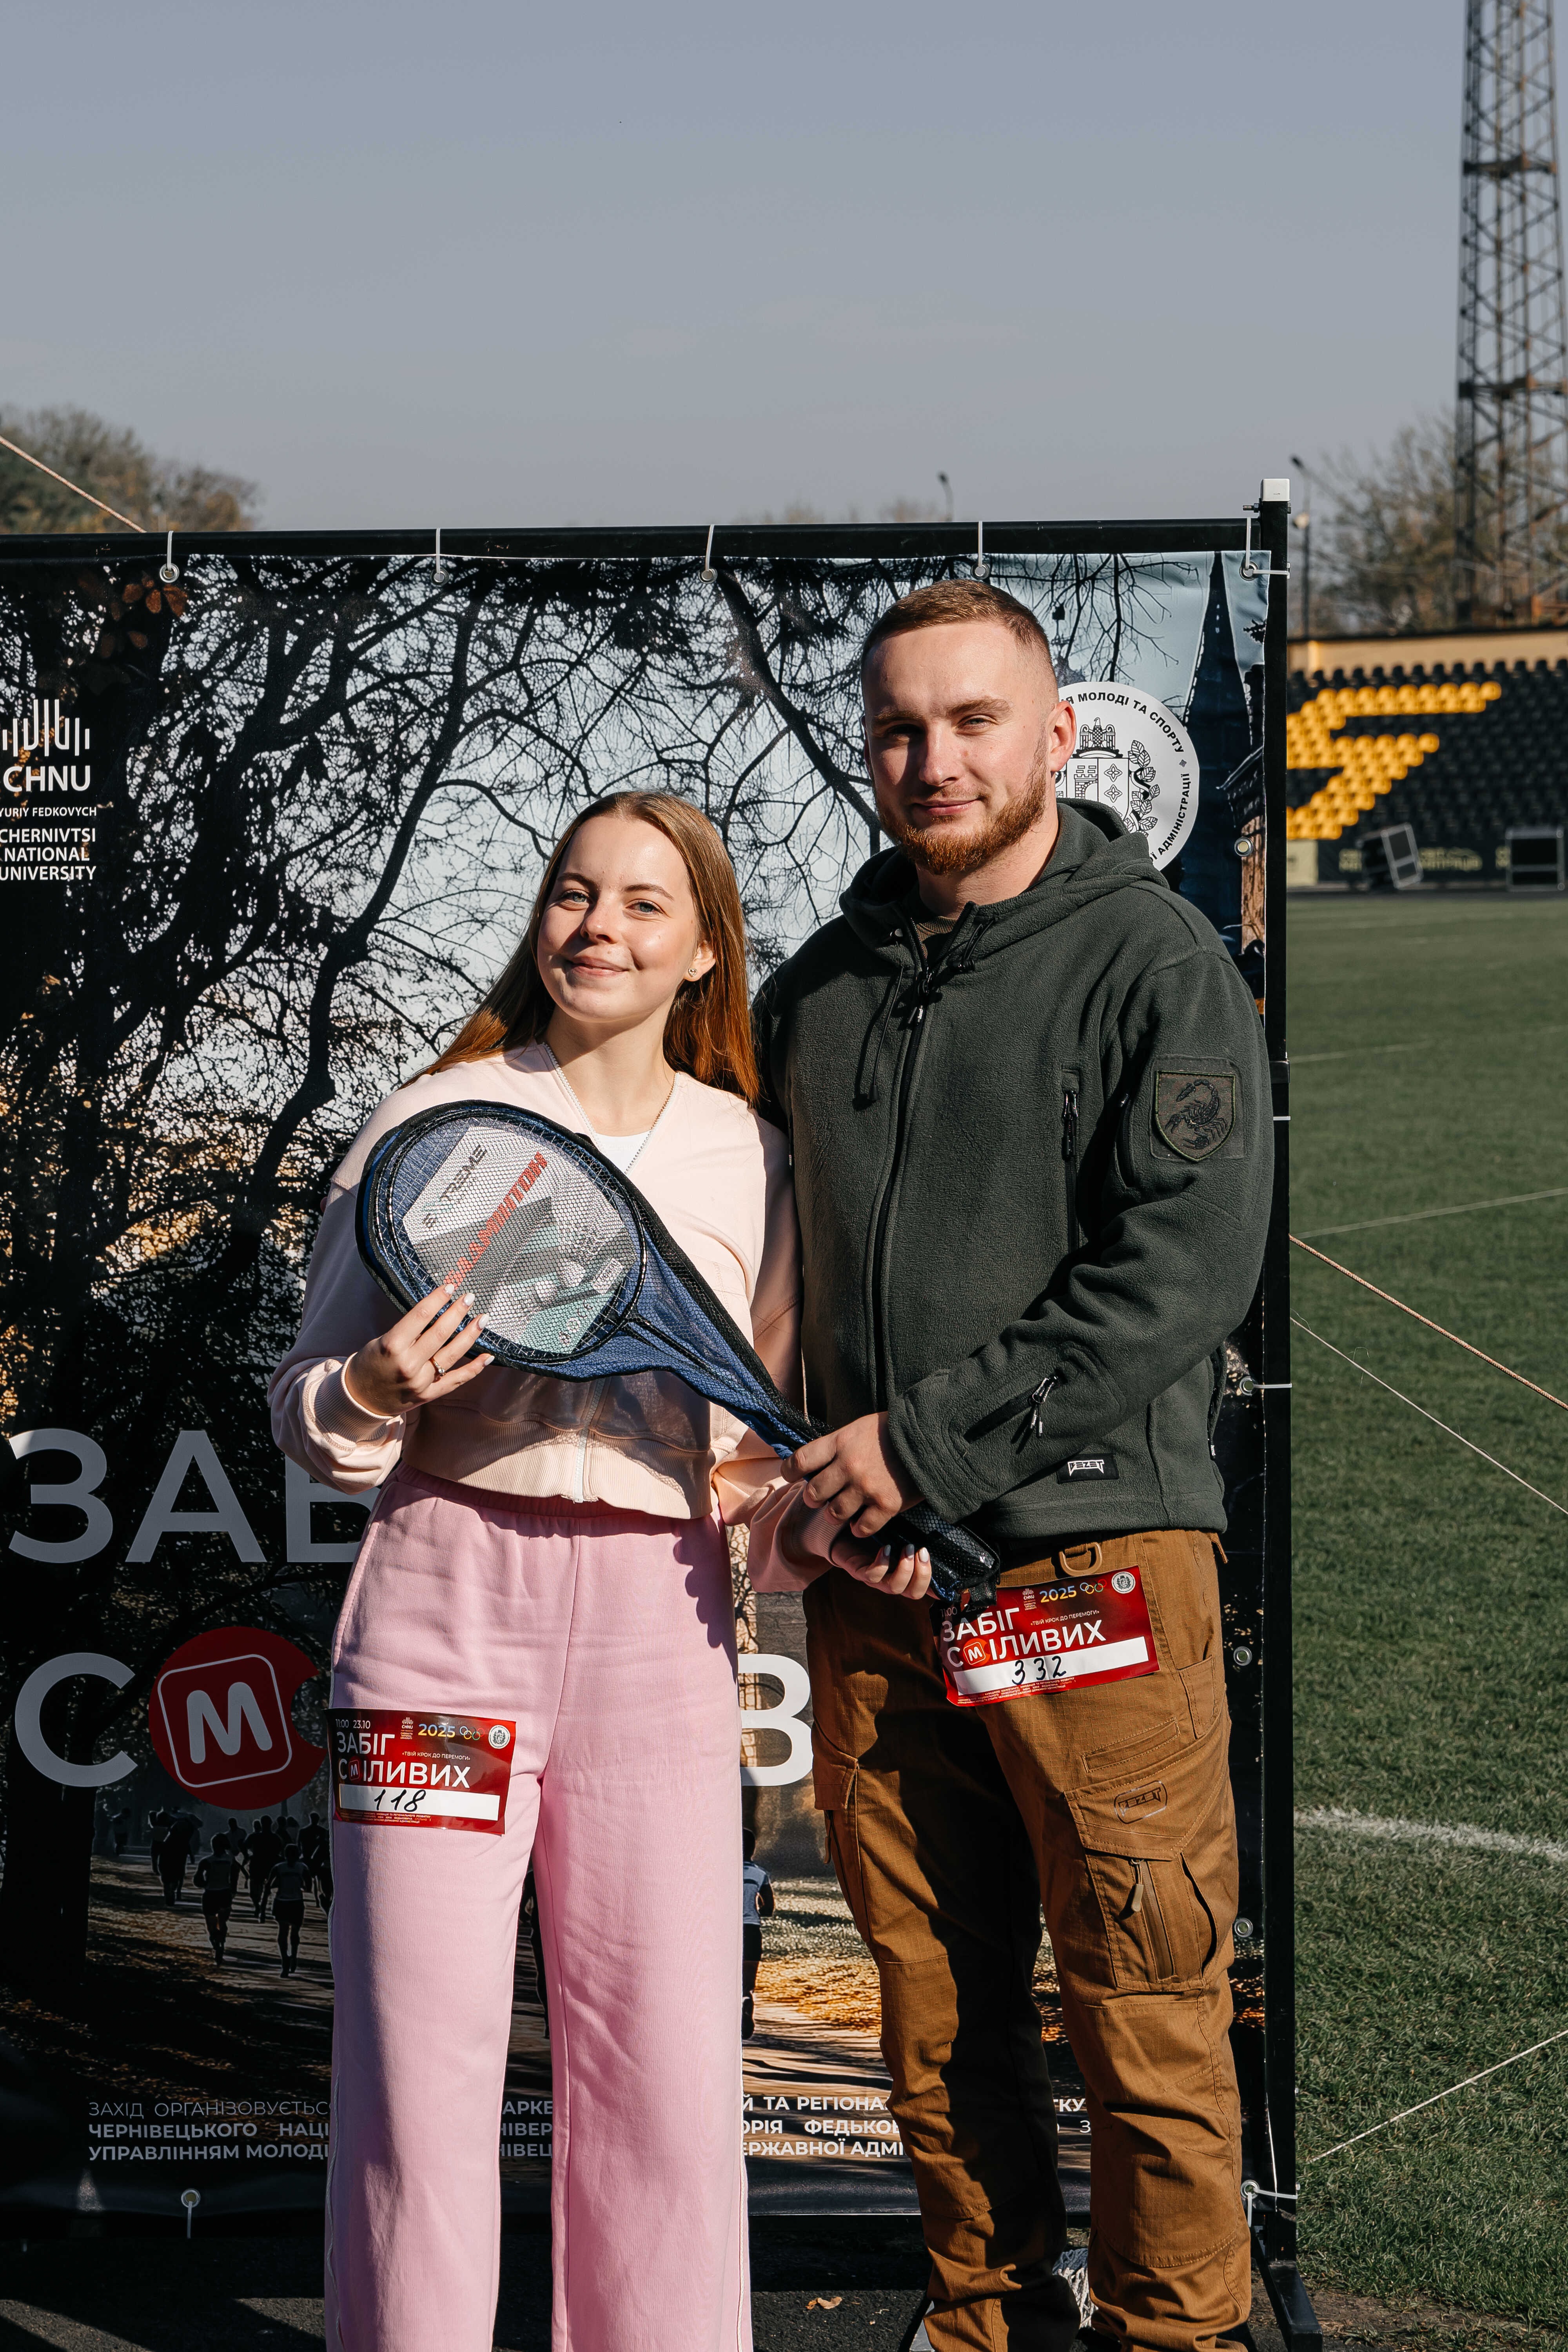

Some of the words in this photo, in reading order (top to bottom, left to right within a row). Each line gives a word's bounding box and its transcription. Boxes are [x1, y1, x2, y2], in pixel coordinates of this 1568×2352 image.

[1078, 692, 1129, 706] МОЛОДІ
[1133, 700, 1147, 715] ТА
[1149, 712, 1184, 752] СПОРТУ
[3, 765, 91, 791] CHNU
[0, 808, 29, 817] YURIY
[32, 807, 97, 817] FEDKOVYCH
[1158, 773, 1191, 855] АДМІНІСТРАЦІЇ
[0, 828, 96, 843] CHERNIVTSI
[5, 847, 90, 862] NATIONAL
[0, 866, 97, 881] UNIVERSITY
[1039, 1585, 1077, 1603] 2025
[942, 1607, 1020, 1642] ЗАБІГ
[1011, 1655, 1067, 1686] 332
[336, 1719, 349, 1728] 11:00
[353, 1720, 370, 1729] 23.10
[418, 1723, 456, 1738] 2025
[337, 1731, 395, 1755] ЗАБІГ
[374, 1789, 426, 1812] 118
[89, 2102, 144, 2119] ЗАХІД
[154, 2101, 331, 2116] ОРГАНІЗОВУЄТЬС
[763, 2096, 790, 2111] ТА
[797, 2096, 889, 2111] РЕГІОНА
[89, 2123, 257, 2141] ЧЕРНІВЕЦЬКОГО
[280, 2123, 328, 2139] НАЦІ
[89, 2145, 240, 2161] УПРАВЛІННЯМ
[246, 2144, 328, 2160] МОЛОДІ
[850, 2141, 904, 2158] АДМІ
